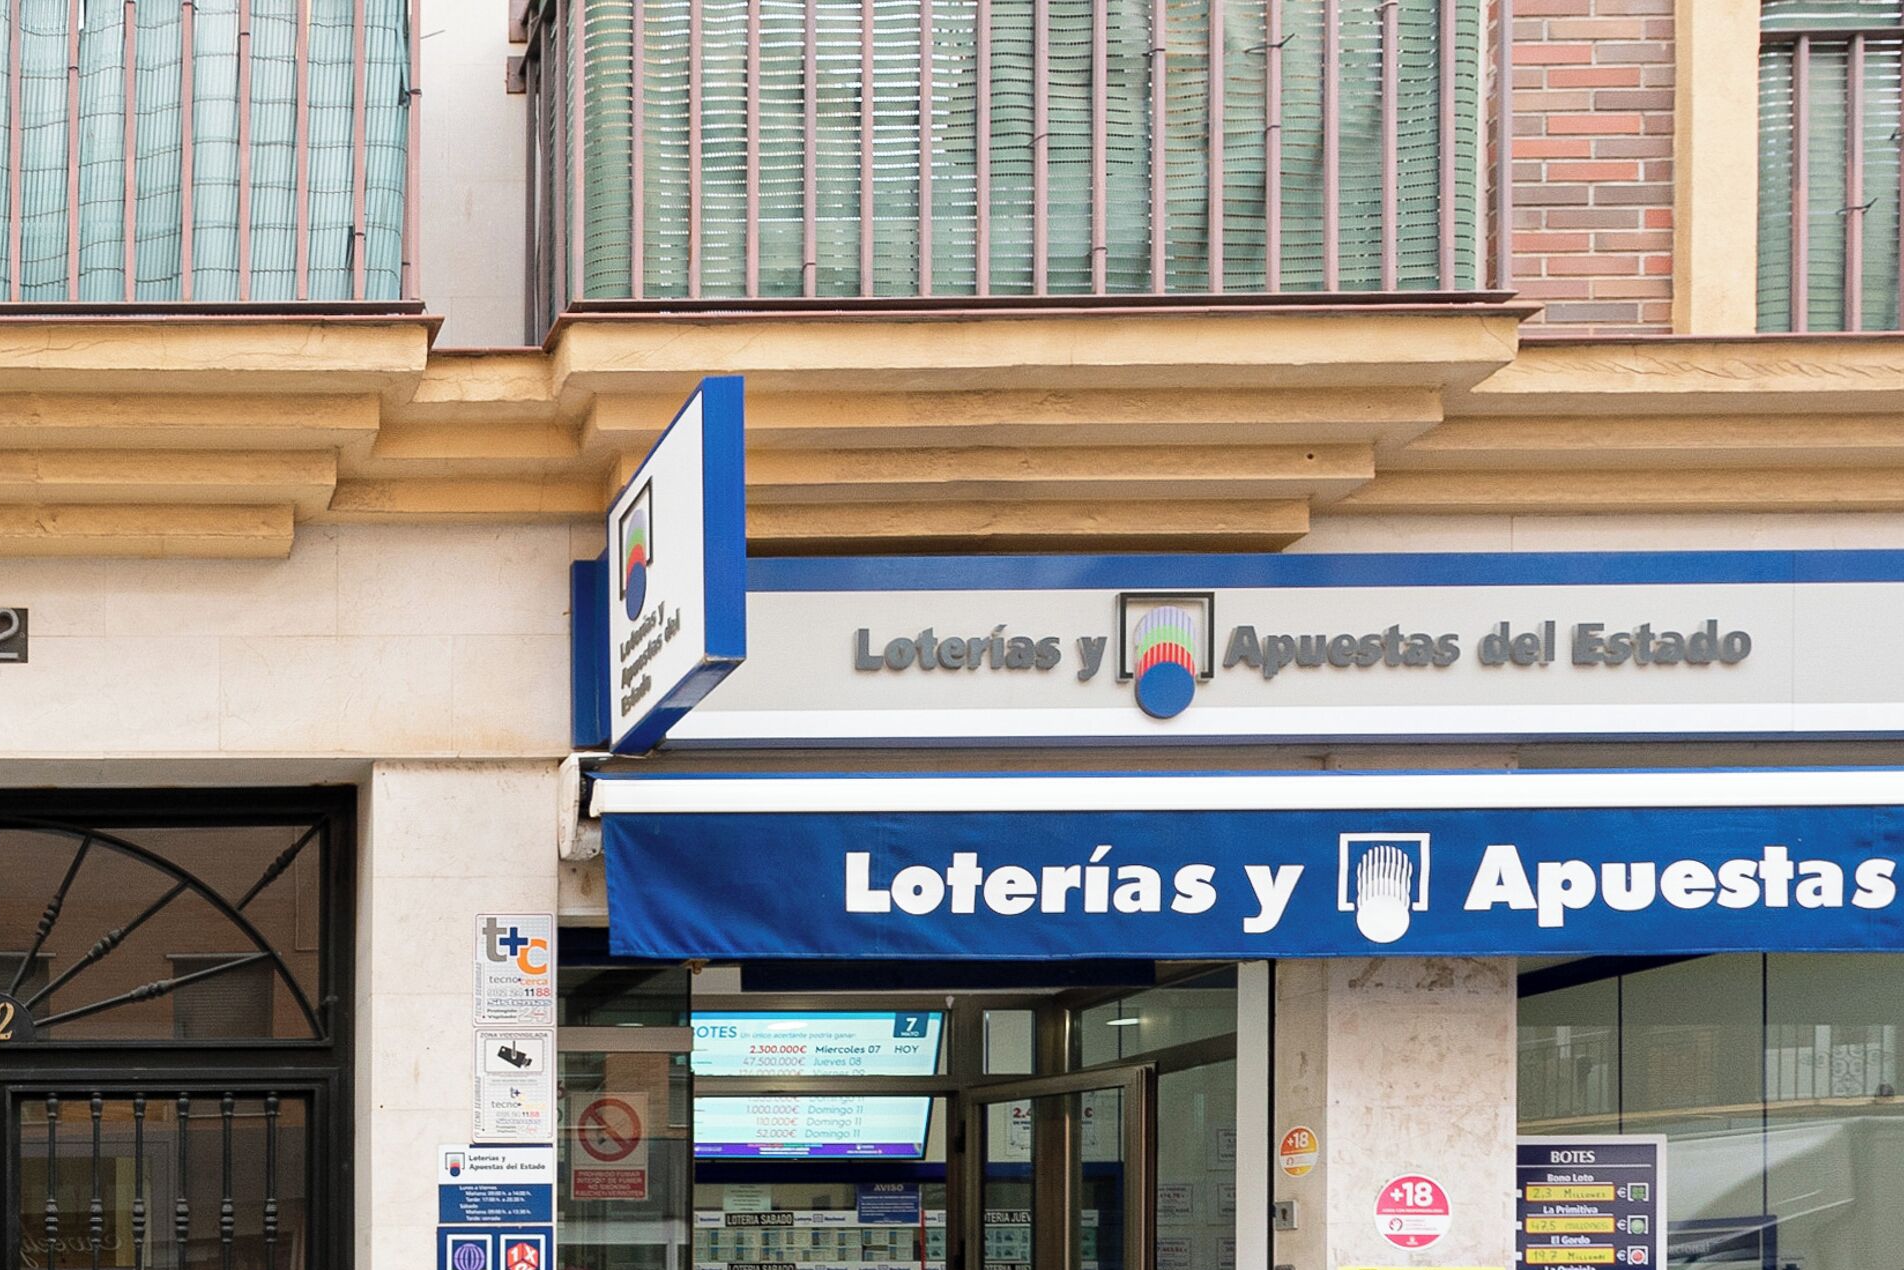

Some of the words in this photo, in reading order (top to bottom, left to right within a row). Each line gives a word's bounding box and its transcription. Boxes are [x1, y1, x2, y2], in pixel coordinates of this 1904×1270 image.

[854, 624, 1062, 671] Loterías
[1077, 636, 1108, 681] y
[1223, 624, 1460, 680] Apuestas
[1478, 620, 1555, 667] del
[1572, 619, 1752, 667] Estado
[845, 845, 1217, 915] Loterías
[1243, 864, 1305, 934] y
[1463, 844, 1897, 928] Apuestas
[906, 1017, 917, 1032] 7
[894, 1044, 920, 1054] HOY
[813, 1057, 846, 1066] Jueves
[807, 1105, 853, 1116] Domingo
[806, 1117, 851, 1127] Domingo
[805, 1129, 850, 1140] Domingo
[1287, 1132, 1309, 1148] +18
[1550, 1151, 1595, 1163] BOTES
[469, 1163, 504, 1171] Apuestas
[1573, 1174, 1594, 1182] Loto
[1390, 1182, 1433, 1207] +18
[1543, 1206, 1554, 1214] La
[1556, 1205, 1598, 1214] Primitiva
[727, 1214, 760, 1225] LOTERIA
[761, 1213, 792, 1225] SABADO
[984, 1212, 1009, 1222] TERIA
[1551, 1236, 1559, 1244] El
[1561, 1235, 1590, 1244] Gordo
